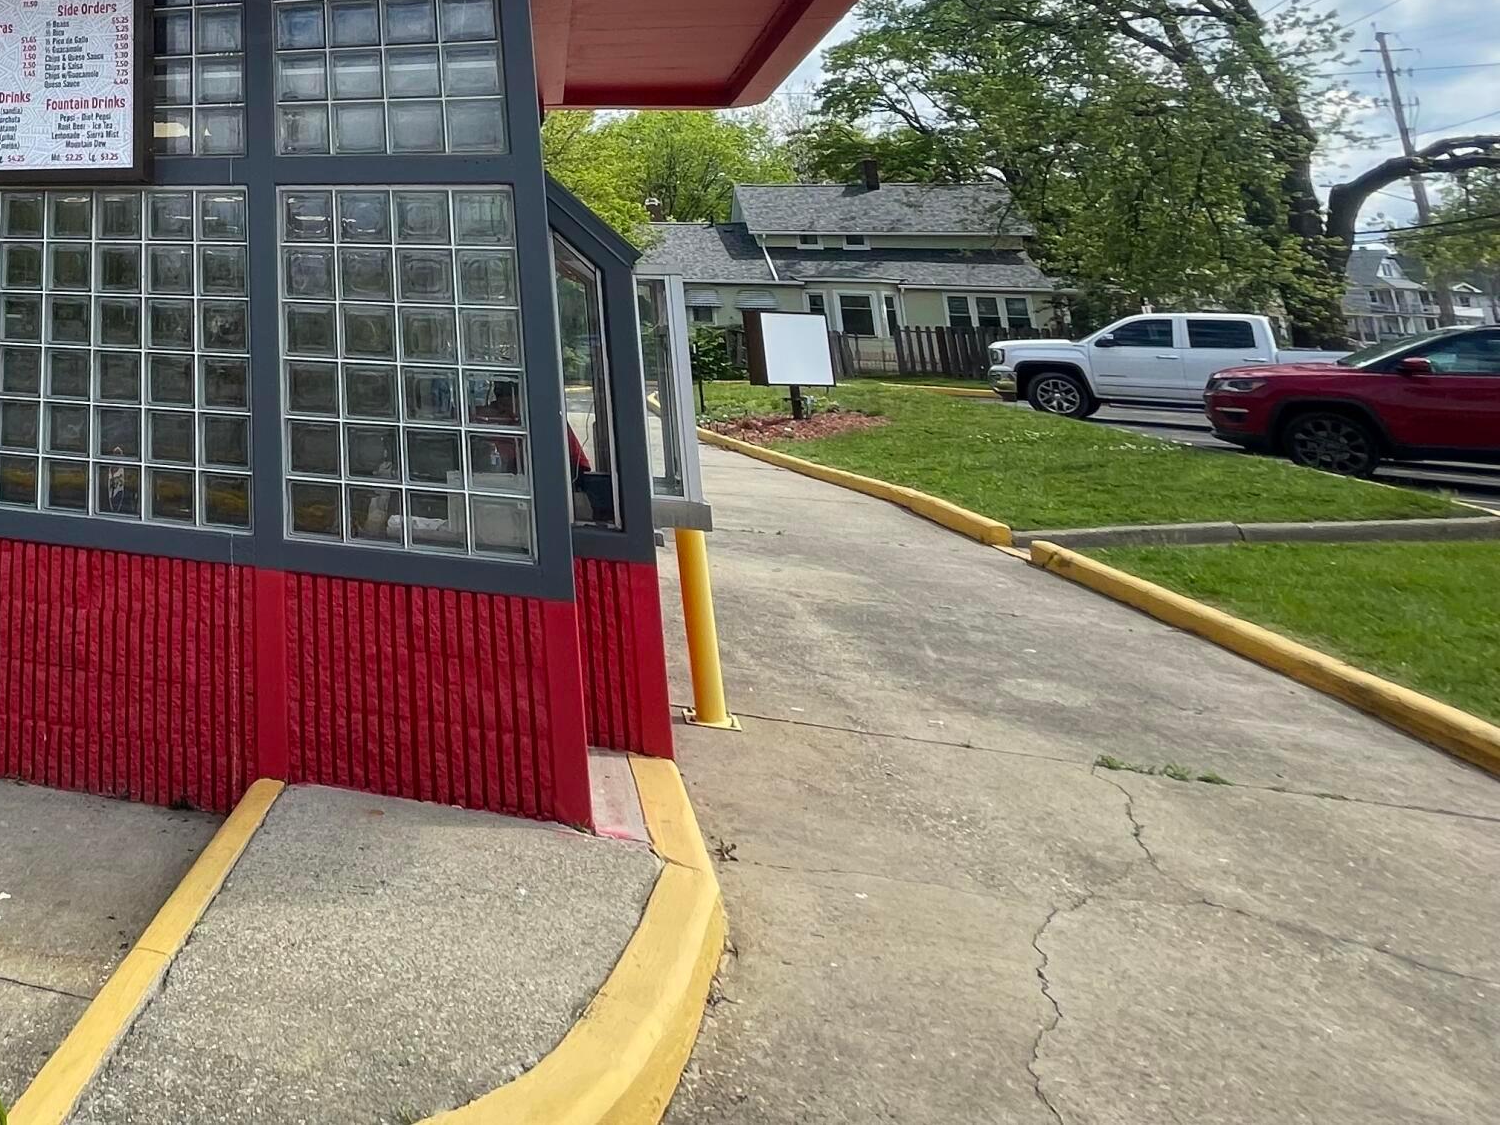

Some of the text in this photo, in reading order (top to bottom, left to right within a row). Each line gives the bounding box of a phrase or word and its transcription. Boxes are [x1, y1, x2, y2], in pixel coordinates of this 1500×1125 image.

[58, 2, 117, 17] Side Orders
[52, 37, 65, 45] Pico
[74, 36, 89, 44] Gallo
[52, 45, 82, 54] Guacamole
[45, 55, 60, 63] Chips
[67, 53, 85, 62] Queso
[86, 52, 104, 60] Sauce
[45, 63, 60, 72] Chips
[67, 62, 83, 70] Salsa
[45, 72, 60, 80] Chips
[44, 80, 80, 89] Queso Sauce
[0, 91, 31, 104] Drinks
[46, 95, 126, 111] Fountain Drinks
[59, 113, 75, 122] Pepsi
[95, 112, 112, 121] Pepsi
[72, 122, 86, 130] Beer
[92, 122, 102, 130] Ice
[103, 121, 114, 130] Tea
[51, 132, 81, 140] Lemonade
[105, 130, 119, 138] Mist
[65, 139, 107, 148] Mountain Dew
[65, 153, 83, 161] $2.25
[101, 152, 119, 161] $3.25
